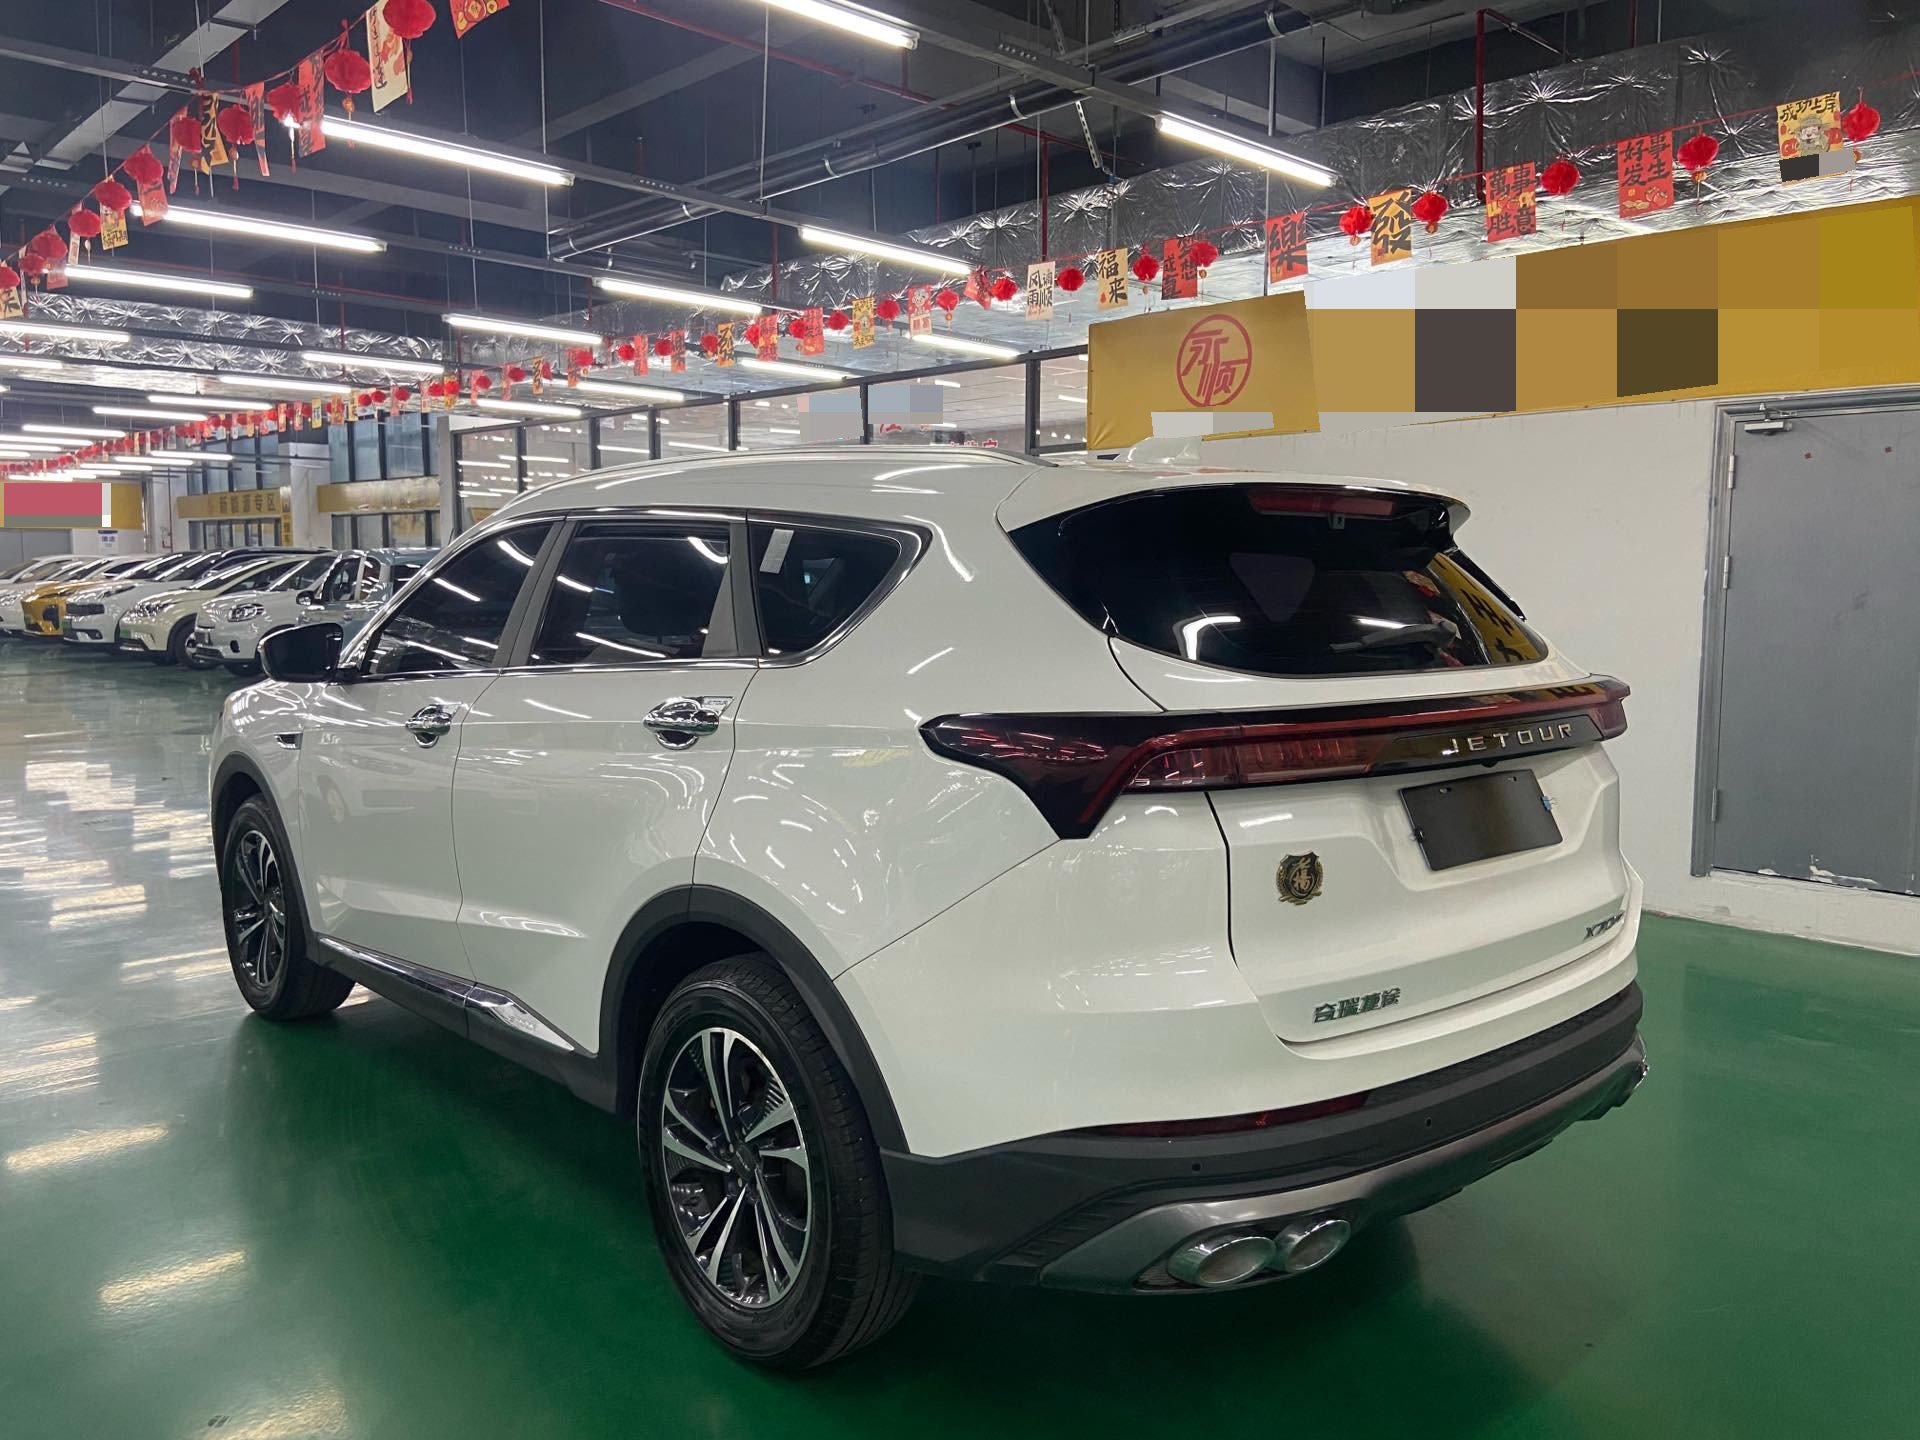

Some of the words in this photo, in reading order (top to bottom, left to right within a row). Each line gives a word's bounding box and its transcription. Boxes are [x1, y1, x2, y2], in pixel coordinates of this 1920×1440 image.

[1620, 134, 1671, 163] 好事
[1621, 159, 1672, 187] 发生
[1441, 723, 1573, 755] JETOUR
